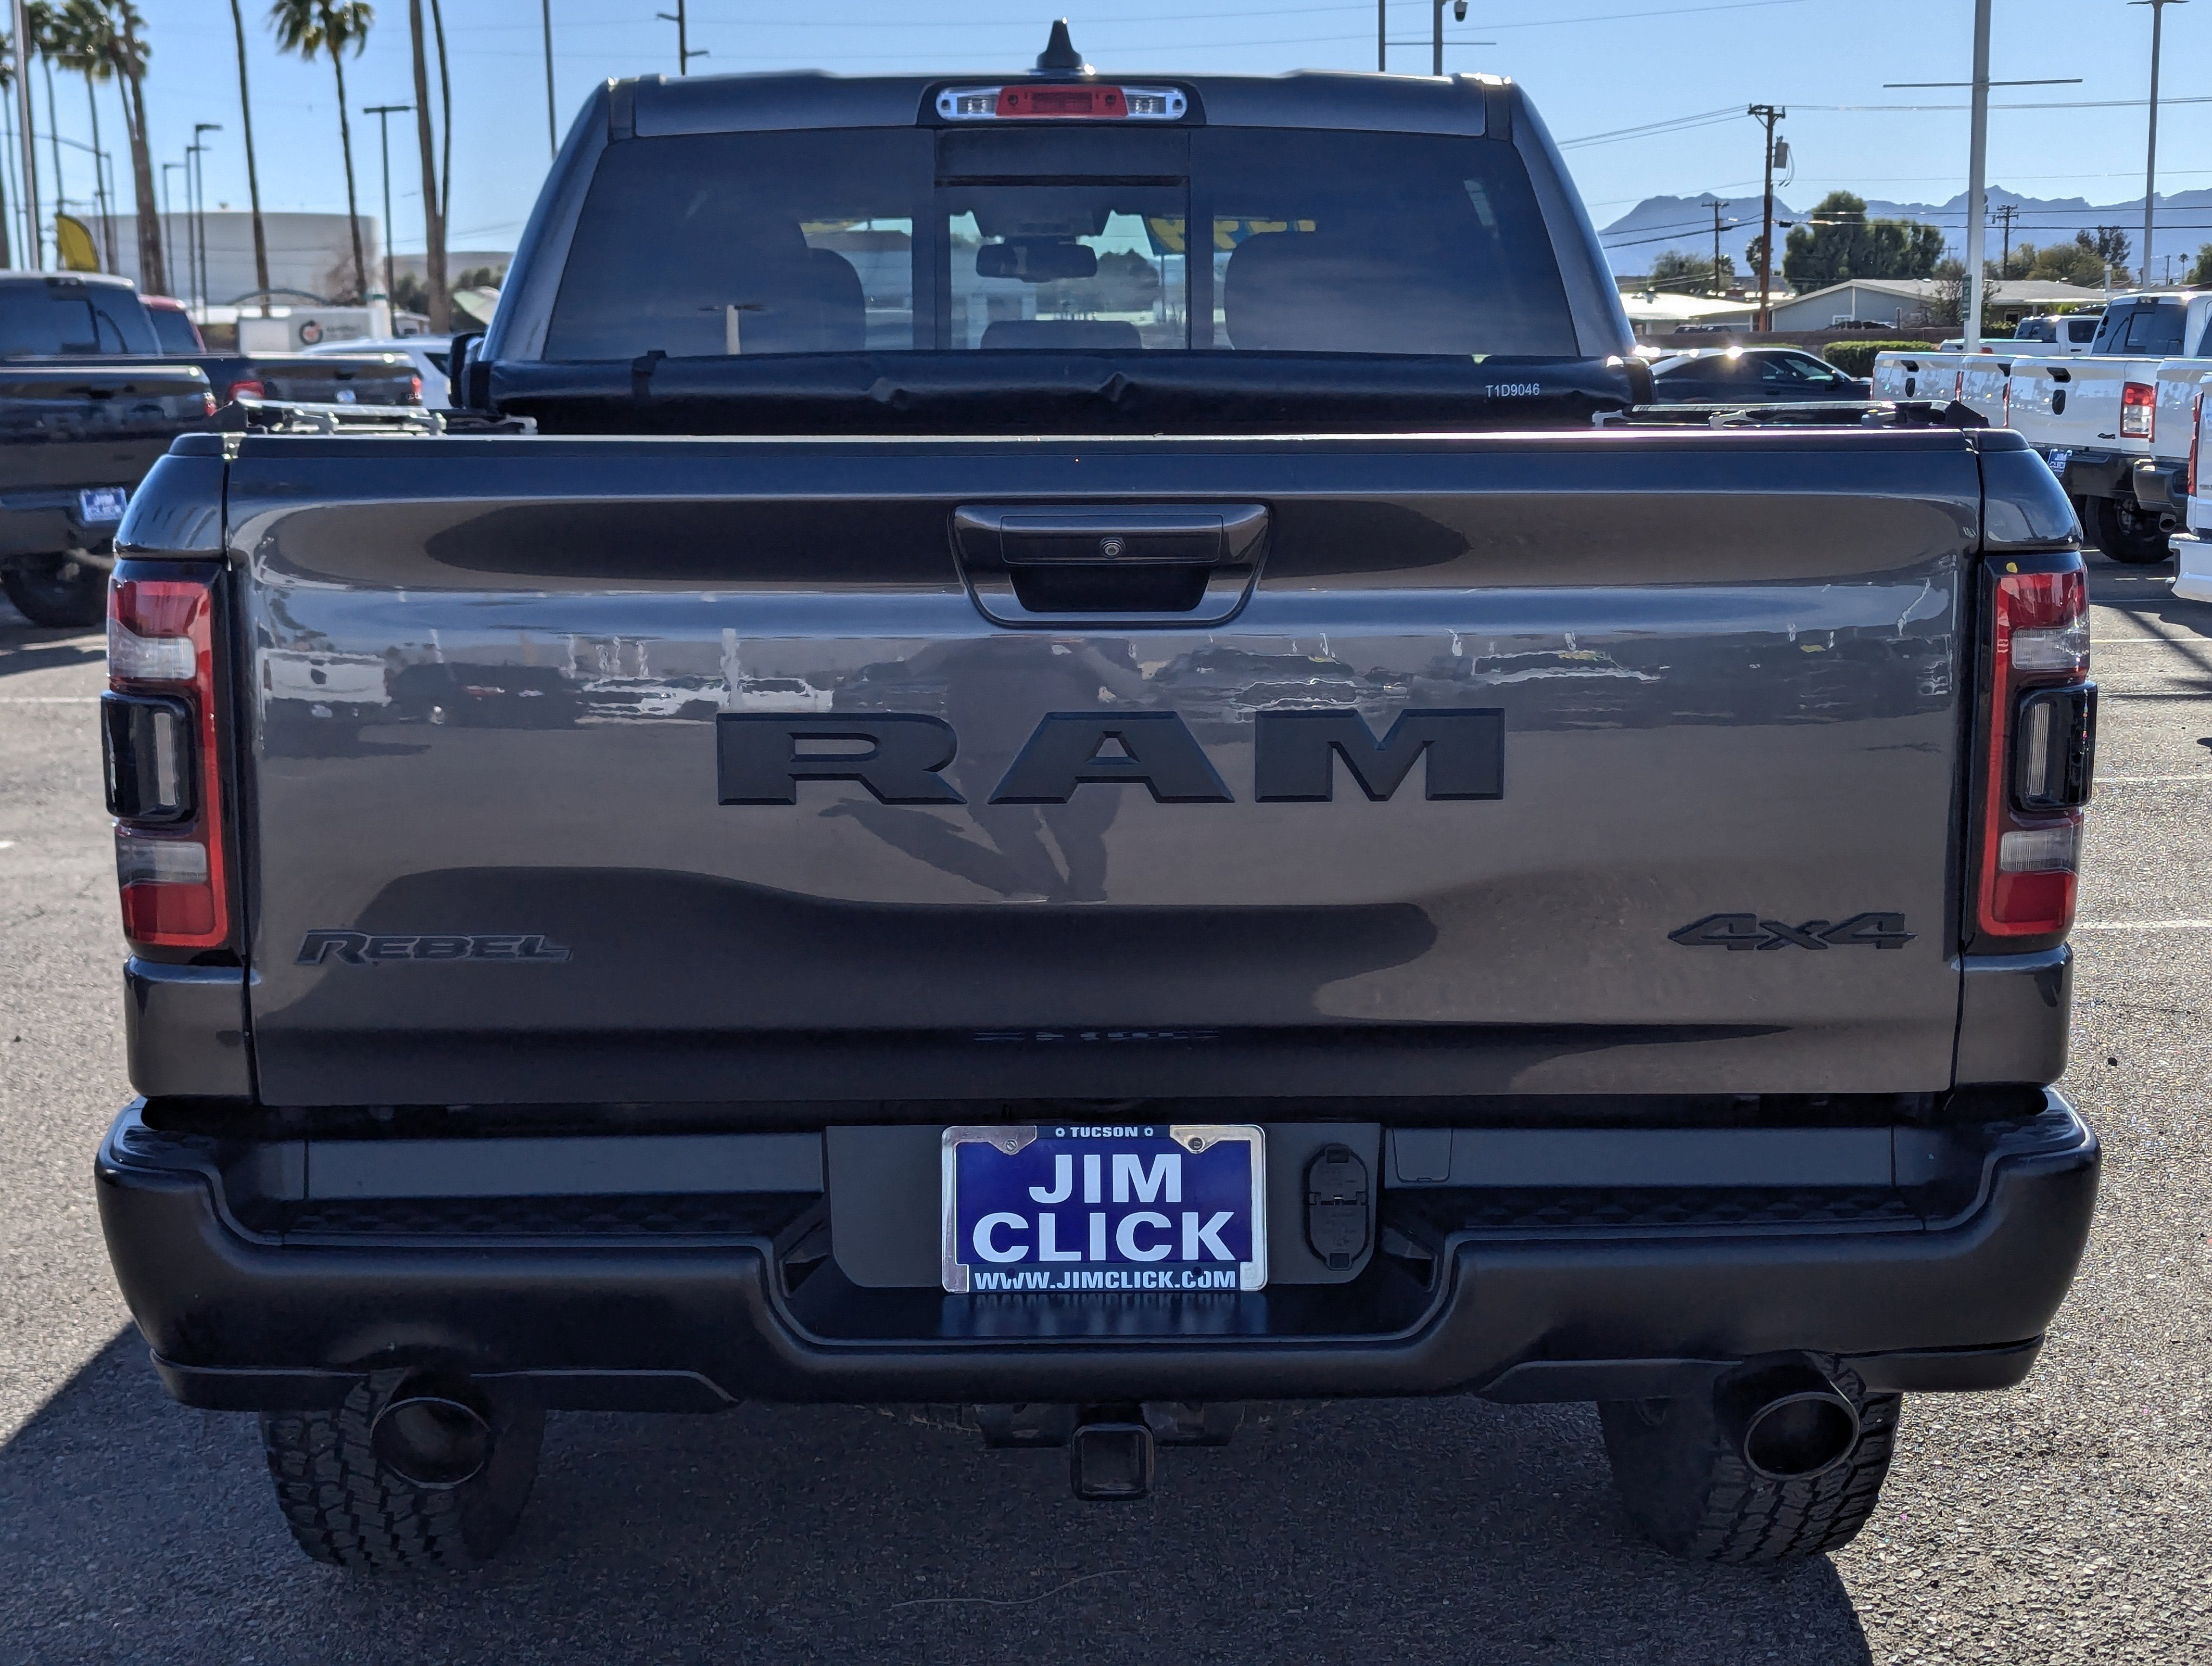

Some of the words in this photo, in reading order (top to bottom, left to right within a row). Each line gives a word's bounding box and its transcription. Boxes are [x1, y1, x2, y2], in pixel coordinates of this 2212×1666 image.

[1486, 383, 1540, 398] T1D9046
[717, 708, 1505, 806] RAM
[294, 929, 573, 965] REBEL
[1070, 1126, 1138, 1138] TUCSON
[1028, 1154, 1182, 1203] JIM
[972, 1211, 1236, 1263] CLICK
[975, 1270, 1236, 1290] WWW.JIMCLICK.COM
